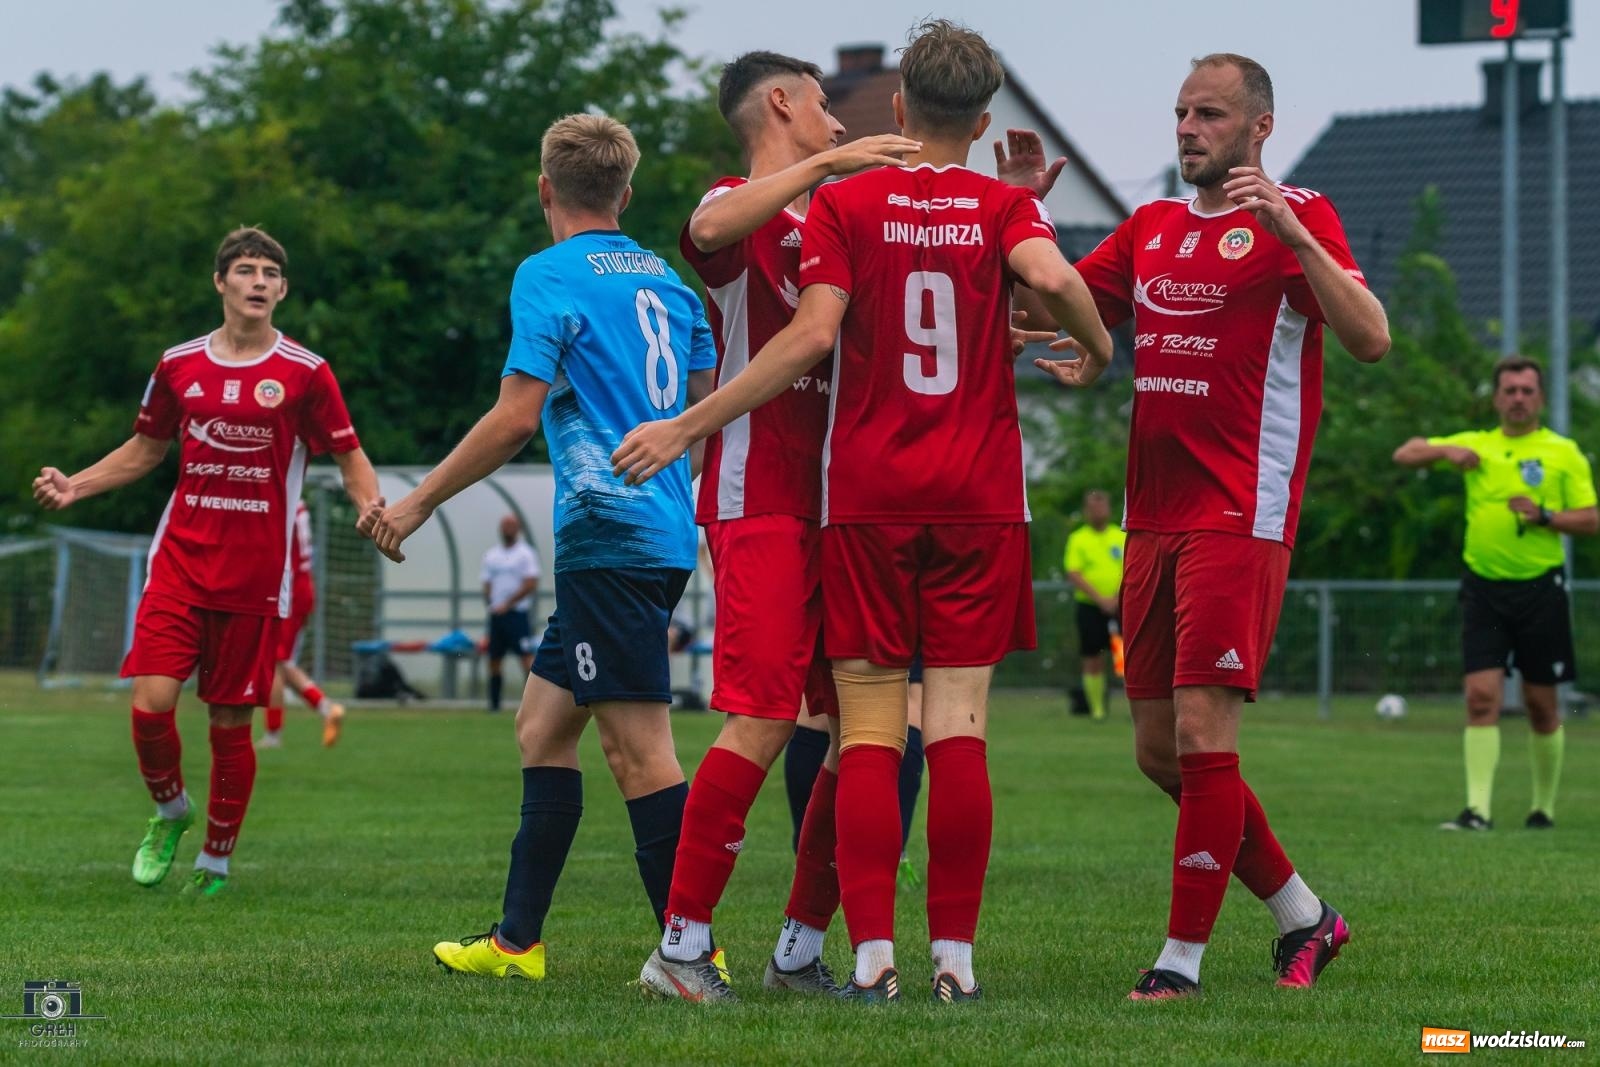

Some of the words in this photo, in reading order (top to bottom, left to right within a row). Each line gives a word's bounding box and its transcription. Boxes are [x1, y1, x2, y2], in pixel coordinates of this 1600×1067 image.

[1490, 0, 1519, 37] 9
[903, 271, 958, 395] 9
[635, 288, 678, 410] 8
[1162, 334, 1218, 350] TRANS
[227, 465, 271, 478] TRANS
[201, 495, 269, 512] WENINGER
[575, 642, 597, 681] 8
[1215, 661, 1244, 670] adidas
[1179, 859, 1221, 871] adidas
